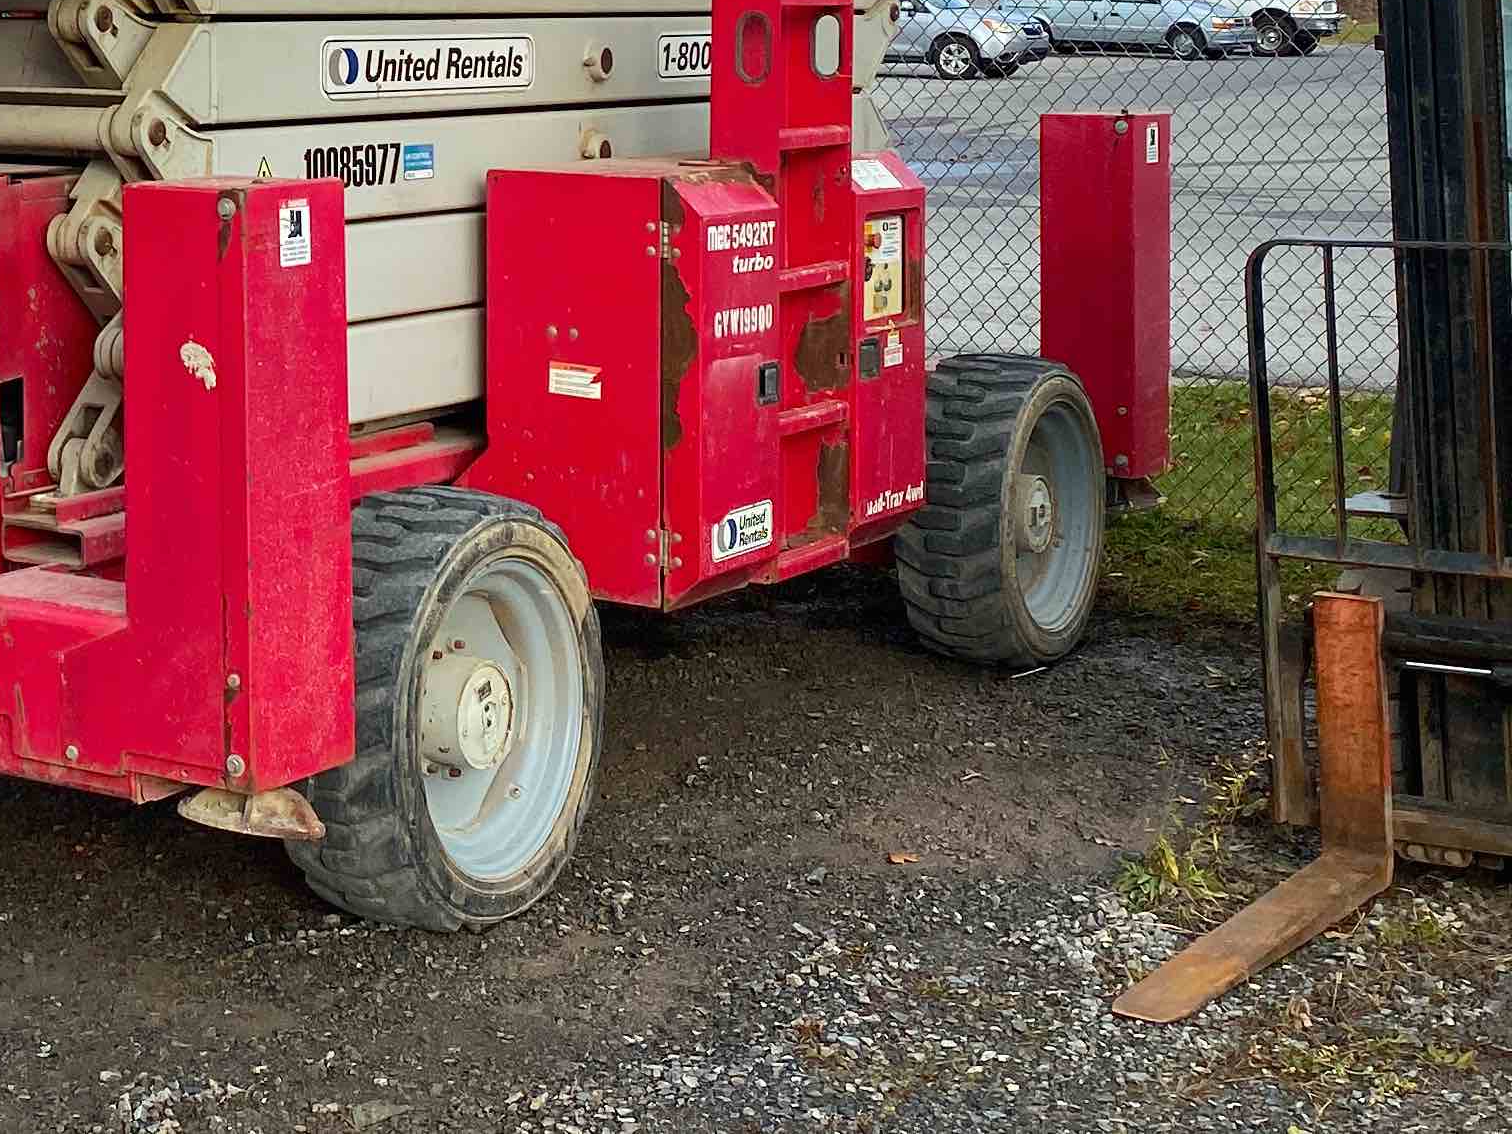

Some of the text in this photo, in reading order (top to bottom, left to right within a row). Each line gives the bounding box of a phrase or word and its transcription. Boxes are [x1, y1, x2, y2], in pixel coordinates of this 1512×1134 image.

[365, 39, 524, 84] United Rentals
[304, 143, 401, 188] 10085977
[731, 221, 776, 249] 5492RT
[732, 251, 774, 274] turbo
[739, 509, 766, 530] United
[739, 526, 768, 546] Rentals
